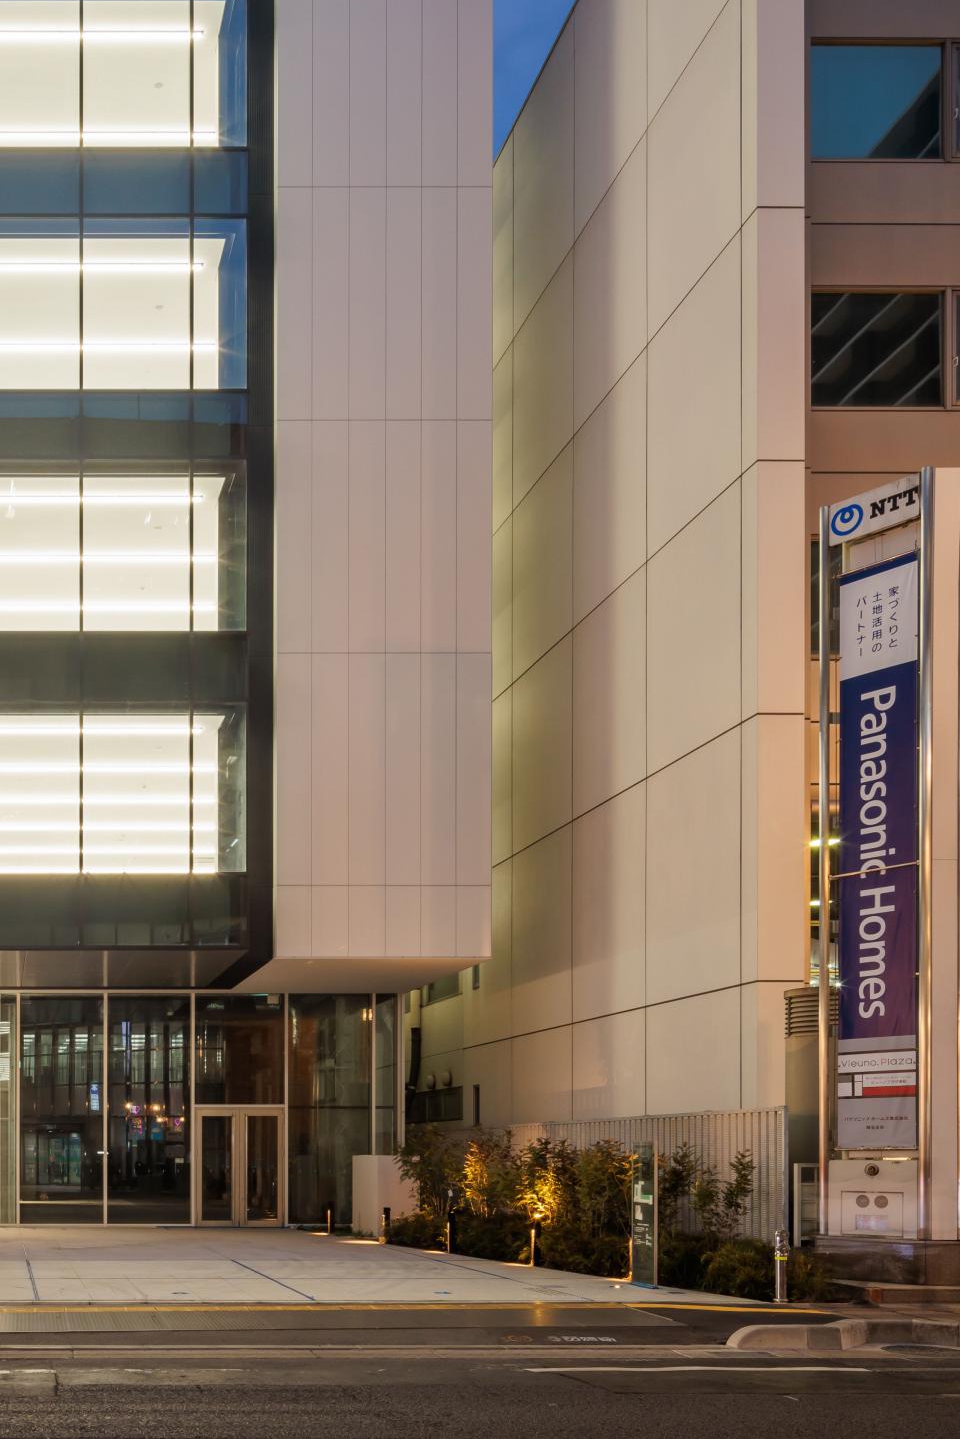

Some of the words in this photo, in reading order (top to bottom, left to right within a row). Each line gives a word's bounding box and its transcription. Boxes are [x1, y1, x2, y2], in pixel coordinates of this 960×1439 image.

[869, 486, 919, 520] NTT
[856, 596, 868, 657] パートナー
[871, 593, 883, 653] 土地活用の
[888, 586, 899, 648] 家づくりと
[859, 685, 897, 879] Panasonic
[858, 885, 896, 1020] Homes
